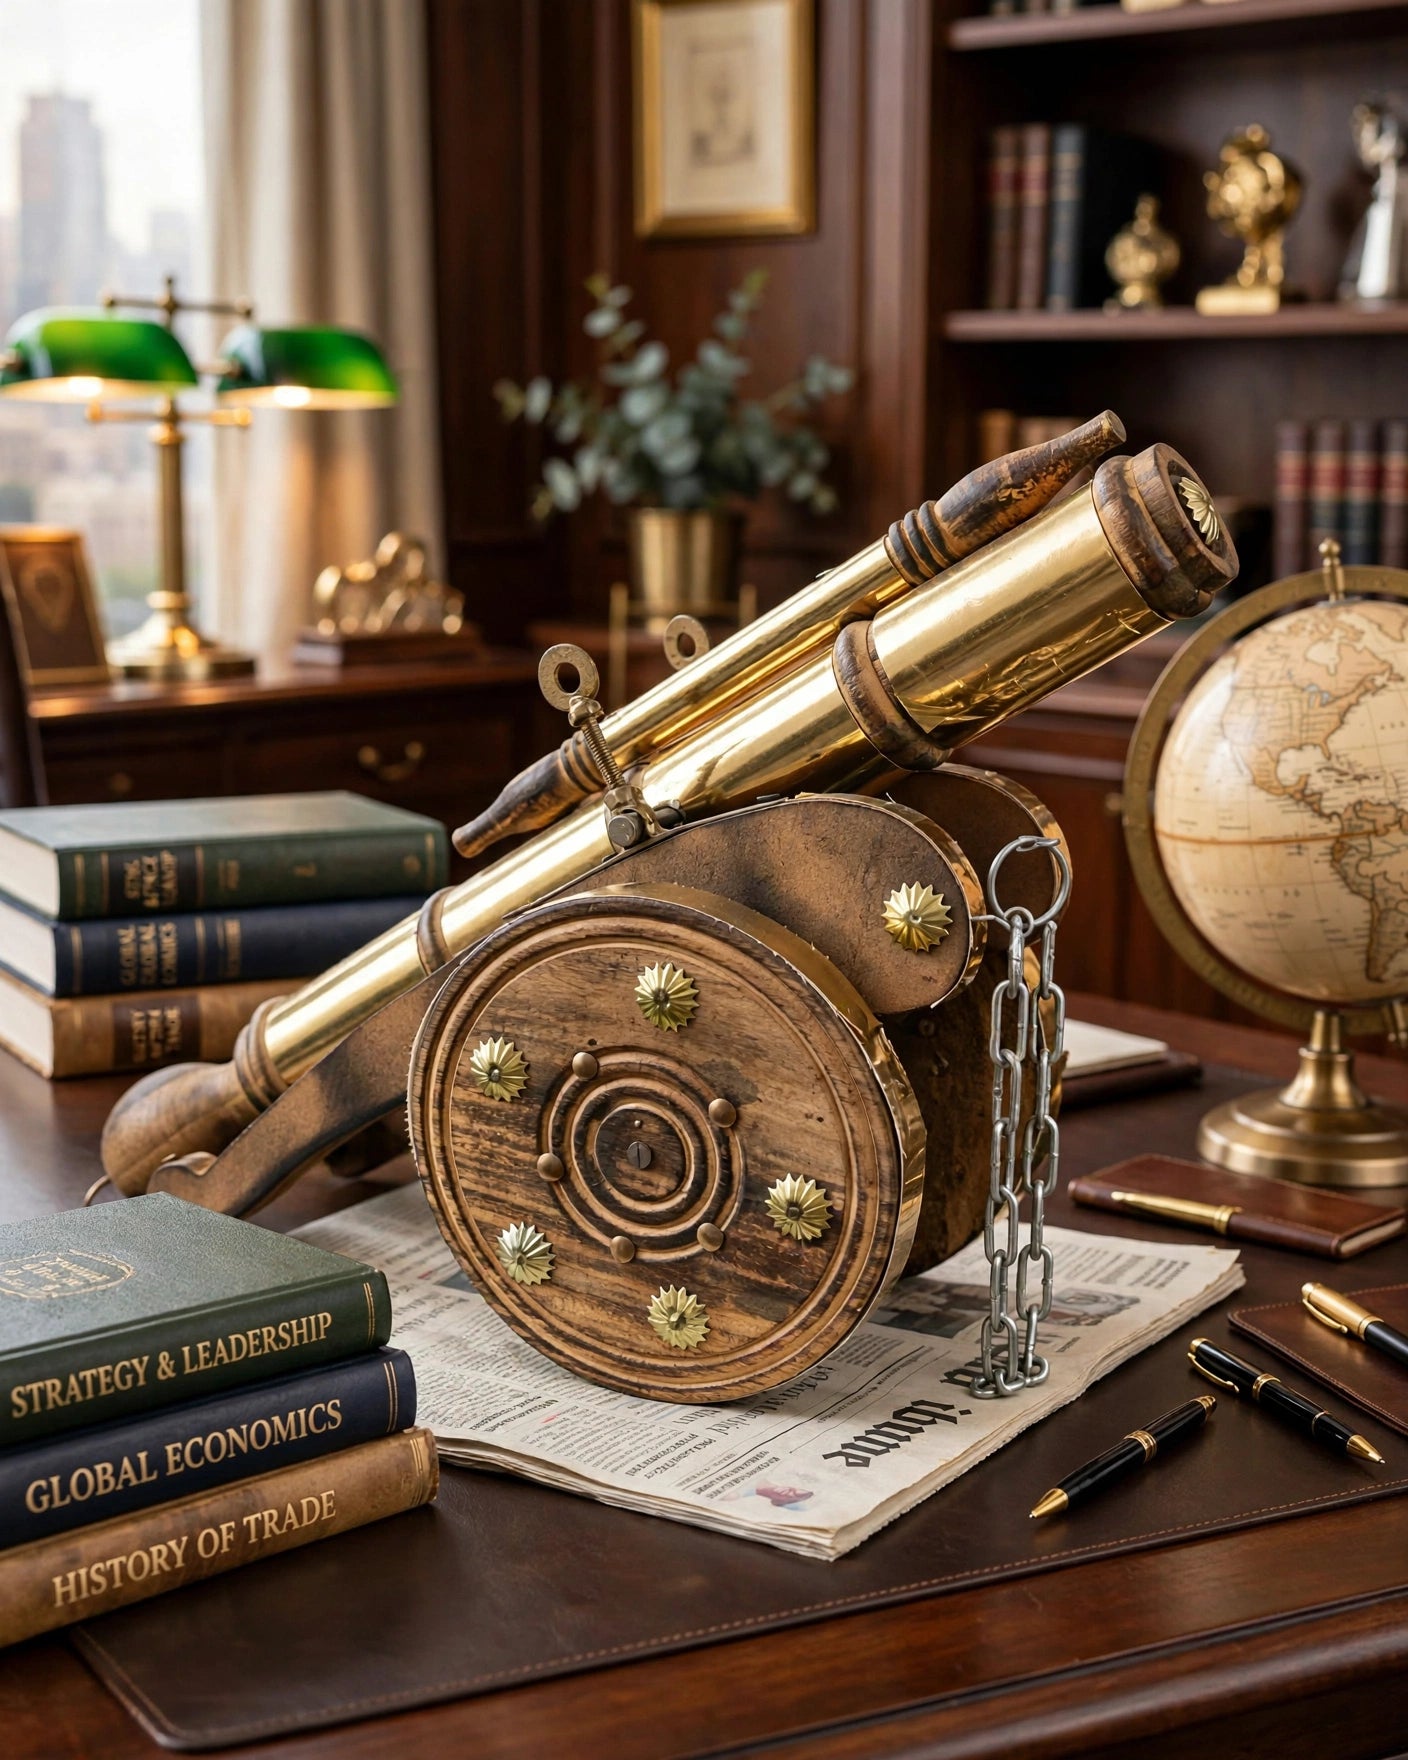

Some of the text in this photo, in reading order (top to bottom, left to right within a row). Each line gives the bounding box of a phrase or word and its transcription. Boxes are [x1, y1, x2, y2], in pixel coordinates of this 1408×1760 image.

[11, 1311, 333, 1419] STRATEGY & LEADERSHIP
[25, 1399, 343, 1515] GLOBAL ECONOMICS
[52, 1490, 337, 1608] HISTORY OF TRADE
